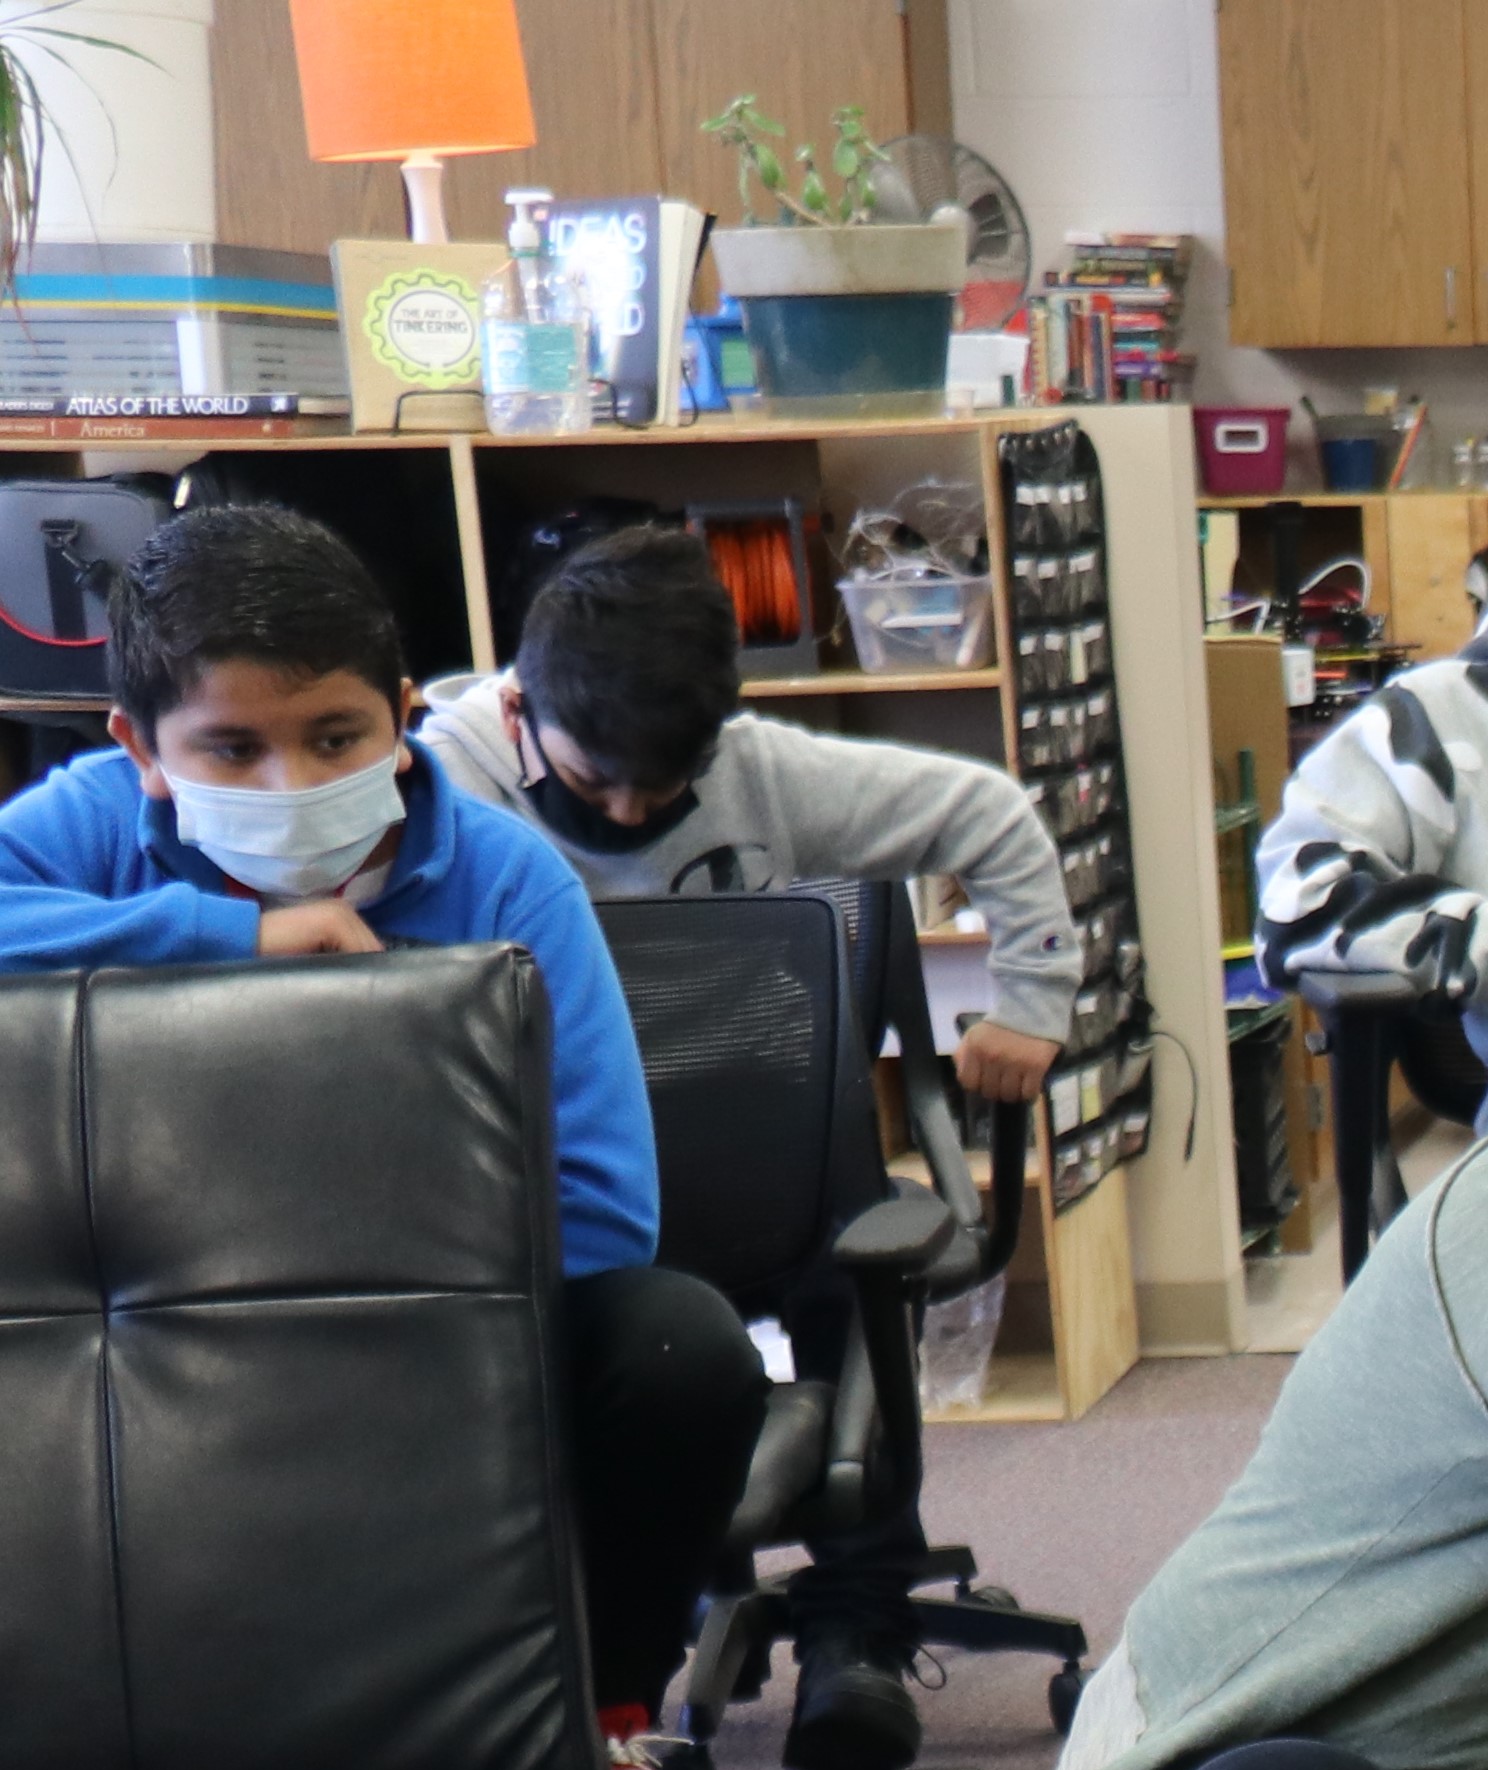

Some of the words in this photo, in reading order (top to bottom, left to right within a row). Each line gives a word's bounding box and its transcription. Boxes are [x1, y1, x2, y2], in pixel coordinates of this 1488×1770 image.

[393, 320, 468, 334] TINKERING
[66, 396, 118, 416] ATLAS
[120, 397, 148, 415] OF
[148, 397, 182, 414] THE
[182, 396, 249, 415] WORLD
[80, 419, 146, 438] America
